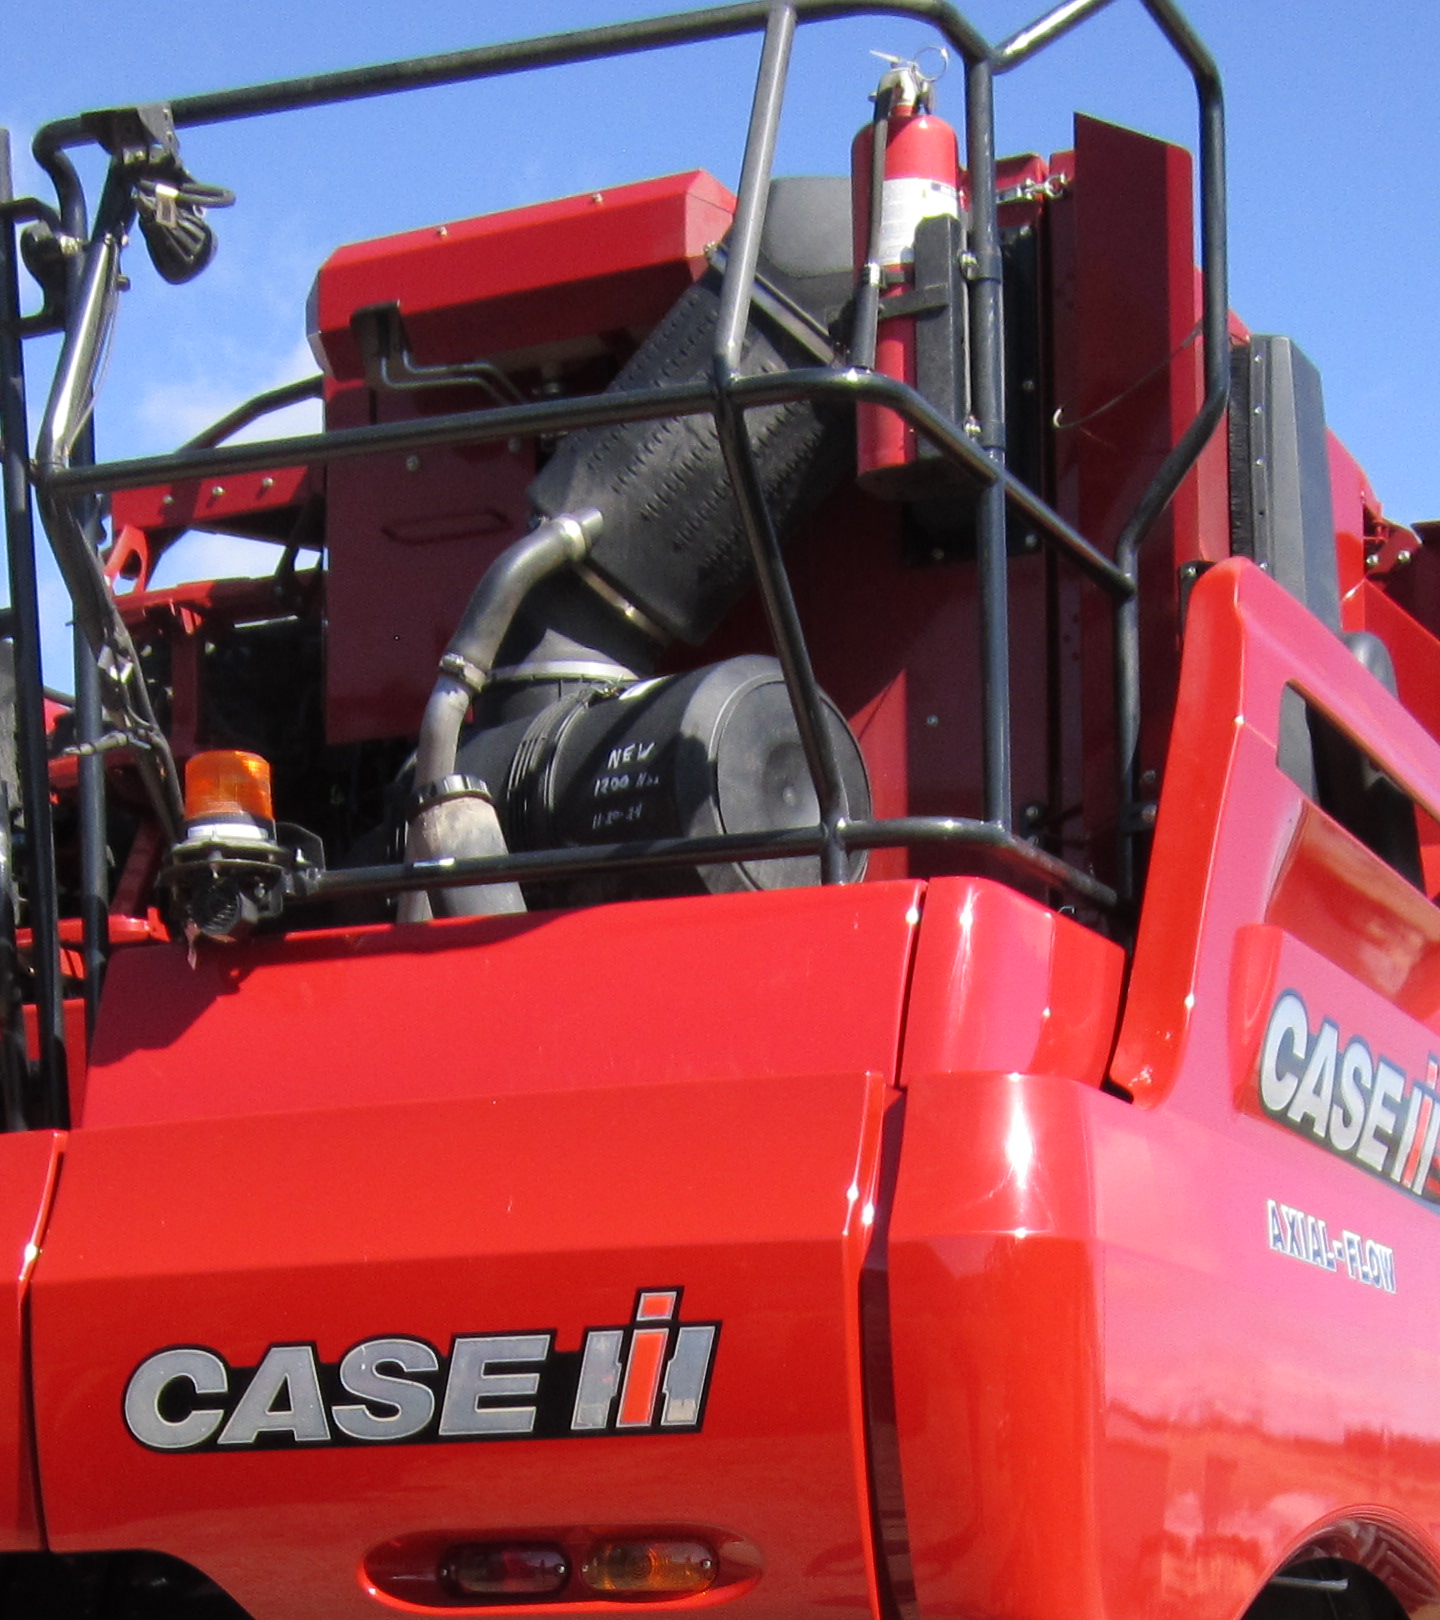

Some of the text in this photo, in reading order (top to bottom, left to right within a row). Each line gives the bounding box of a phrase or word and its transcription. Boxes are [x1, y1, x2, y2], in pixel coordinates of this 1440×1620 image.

[607, 741, 655, 770] NEW
[1261, 994, 1406, 1173] CASE
[1267, 1198, 1397, 1295] AXIAL-FLOW
[124, 1334, 552, 1449] CASE
